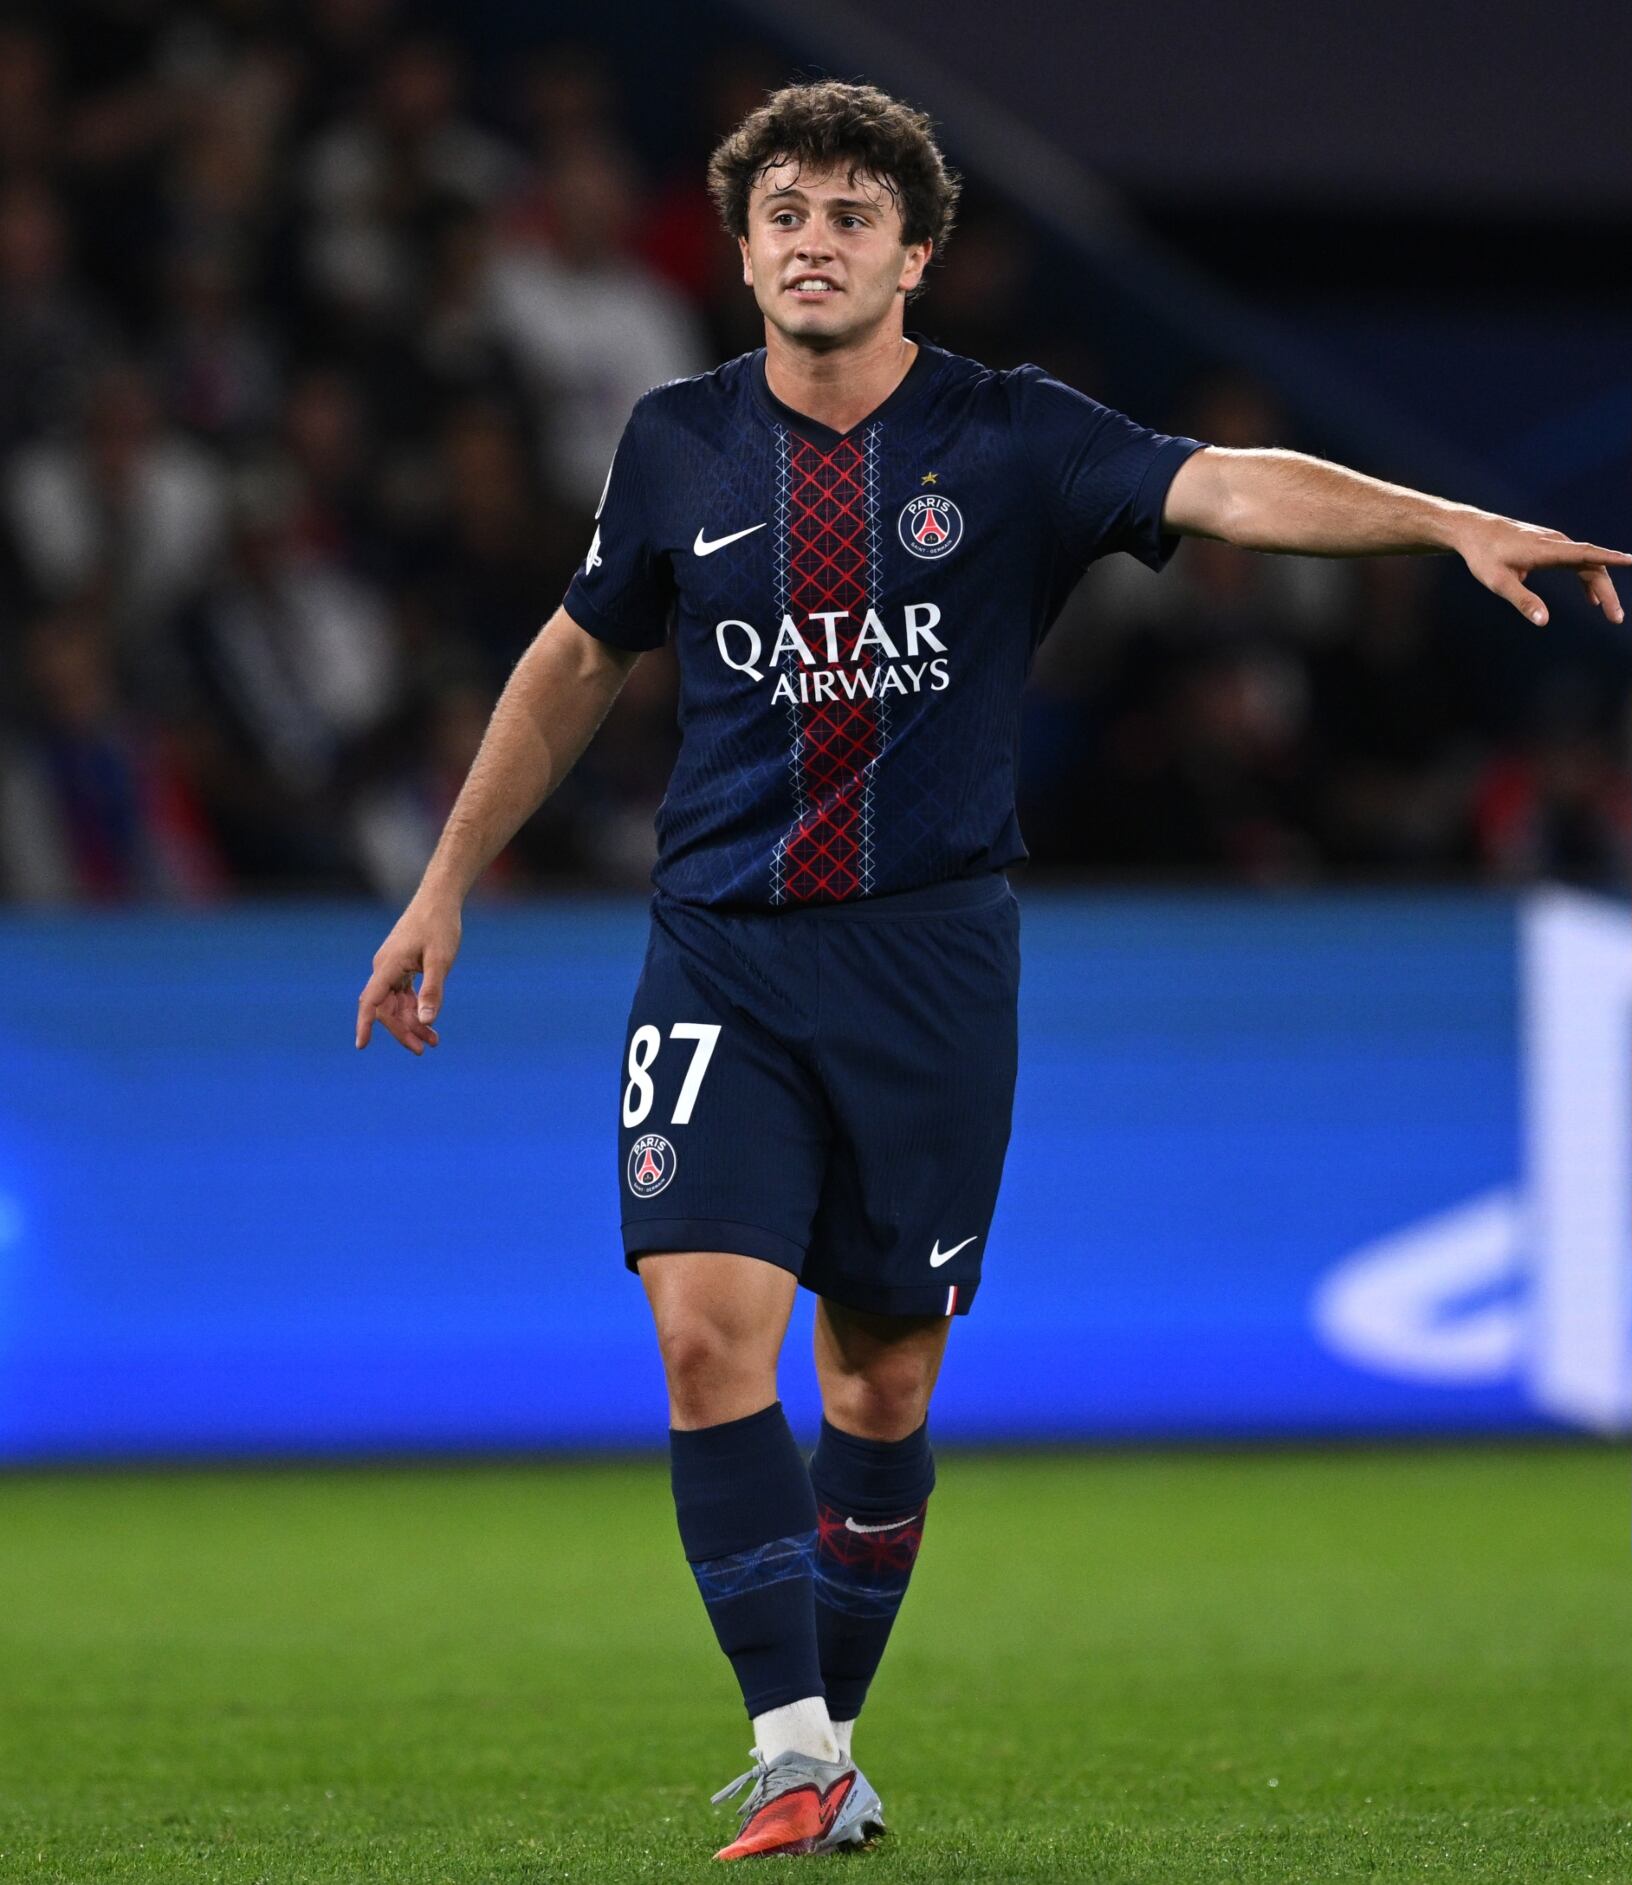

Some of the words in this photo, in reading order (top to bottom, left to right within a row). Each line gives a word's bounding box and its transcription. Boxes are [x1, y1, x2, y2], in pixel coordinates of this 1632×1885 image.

[908, 498, 951, 514] PARIS
[716, 603, 948, 682] QATAR
[771, 658, 950, 705] AIRWAYS
[623, 1023, 722, 1128] 87
[633, 1137, 667, 1155] PARIS
